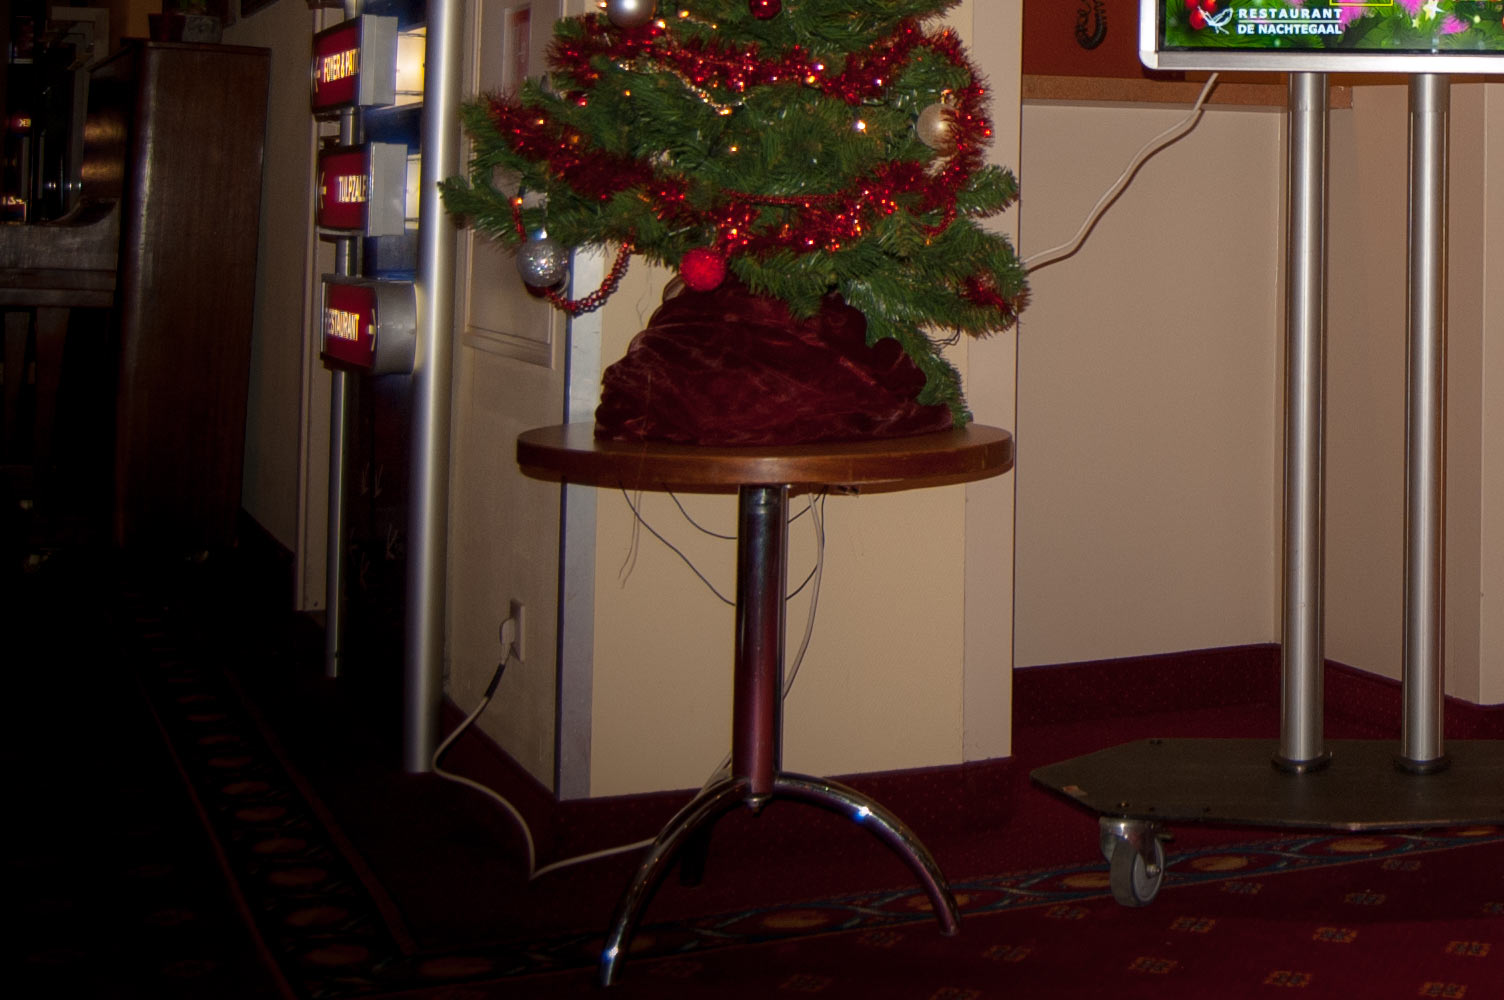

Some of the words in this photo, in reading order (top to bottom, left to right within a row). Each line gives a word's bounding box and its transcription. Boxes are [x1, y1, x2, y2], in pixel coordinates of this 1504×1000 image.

[1238, 8, 1342, 19] RESTAURANT
[1237, 23, 1255, 34] DE
[1258, 23, 1342, 35] NACHTEGAAL
